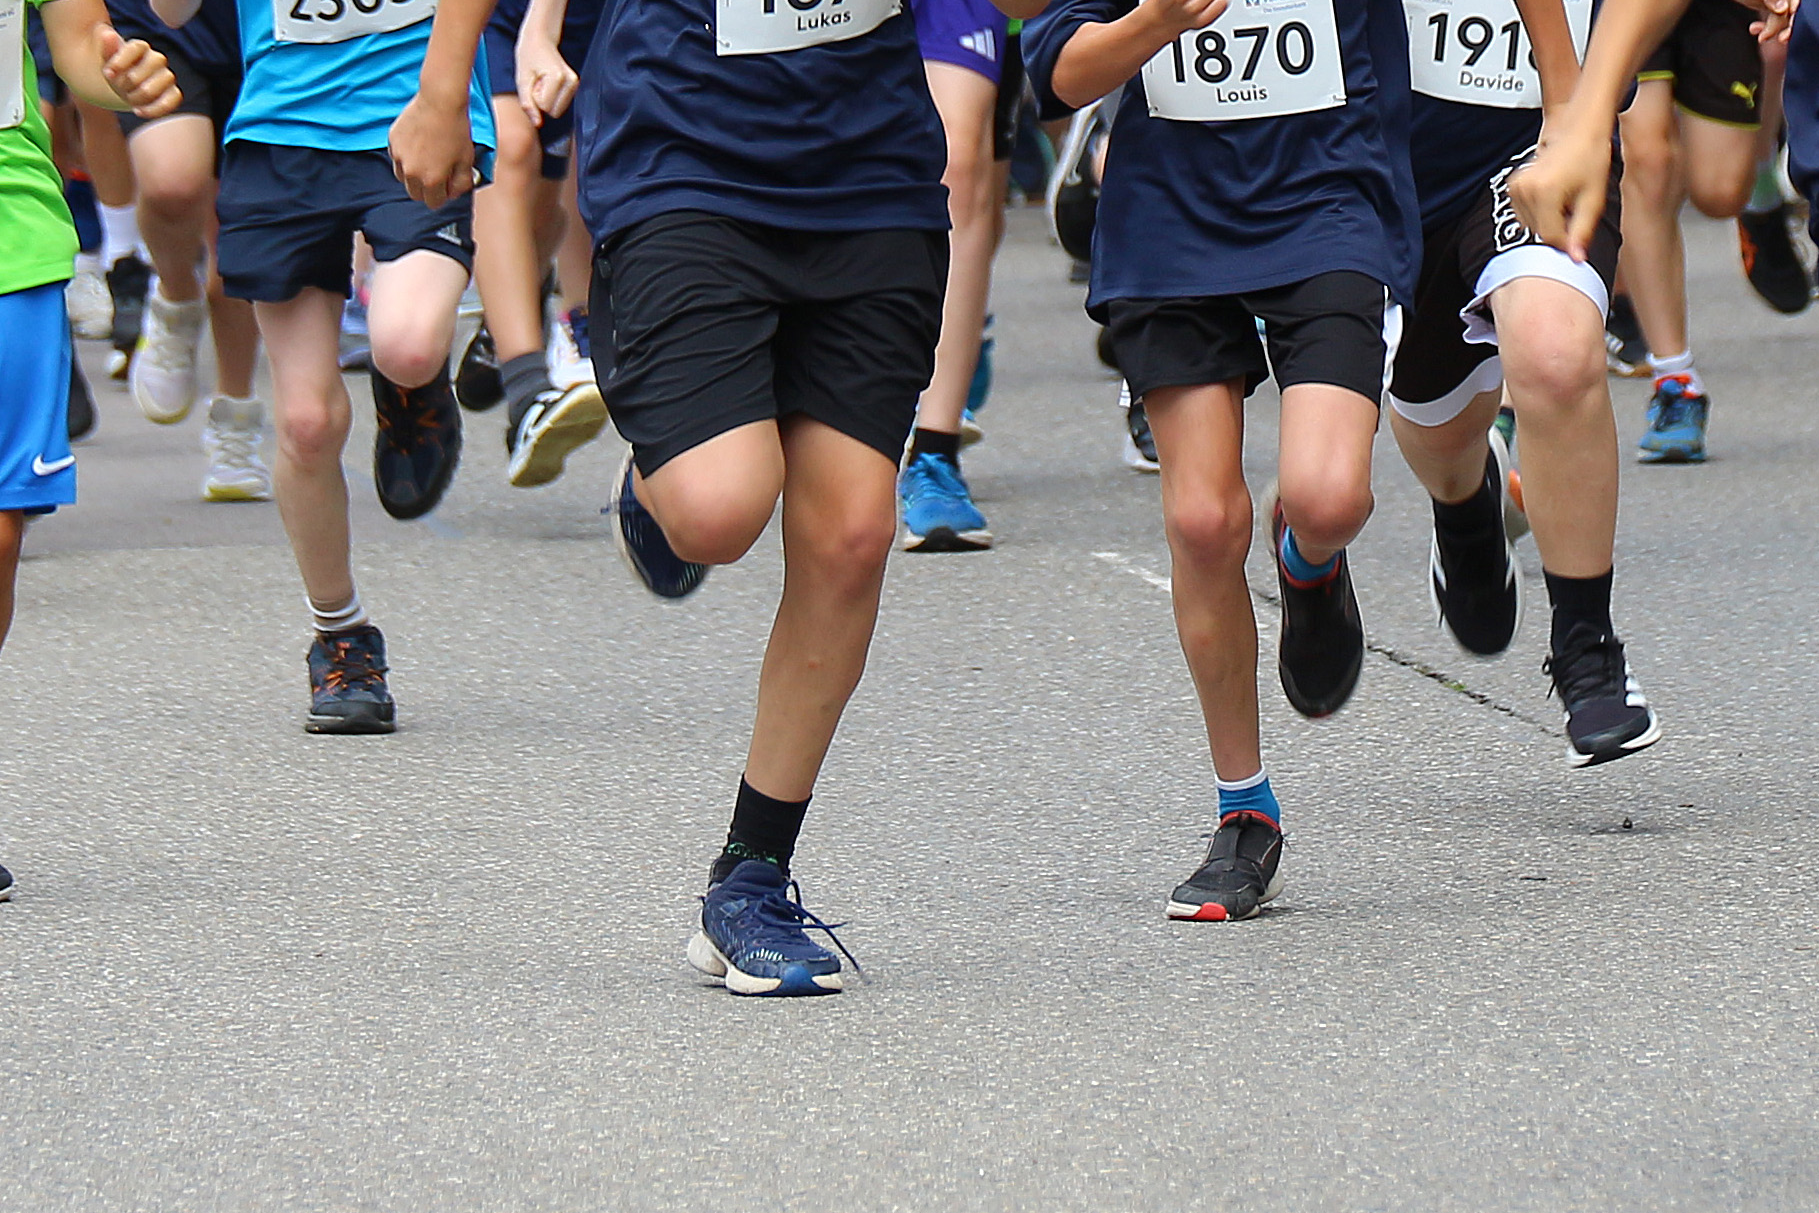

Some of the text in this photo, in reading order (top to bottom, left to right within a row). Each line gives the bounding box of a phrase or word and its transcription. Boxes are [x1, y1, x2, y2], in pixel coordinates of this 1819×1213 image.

[796, 9, 852, 32] Lukas
[1171, 20, 1315, 85] 1870
[1427, 11, 1539, 71] 191
[1459, 70, 1526, 92] Davide
[1216, 87, 1269, 104] Louis
